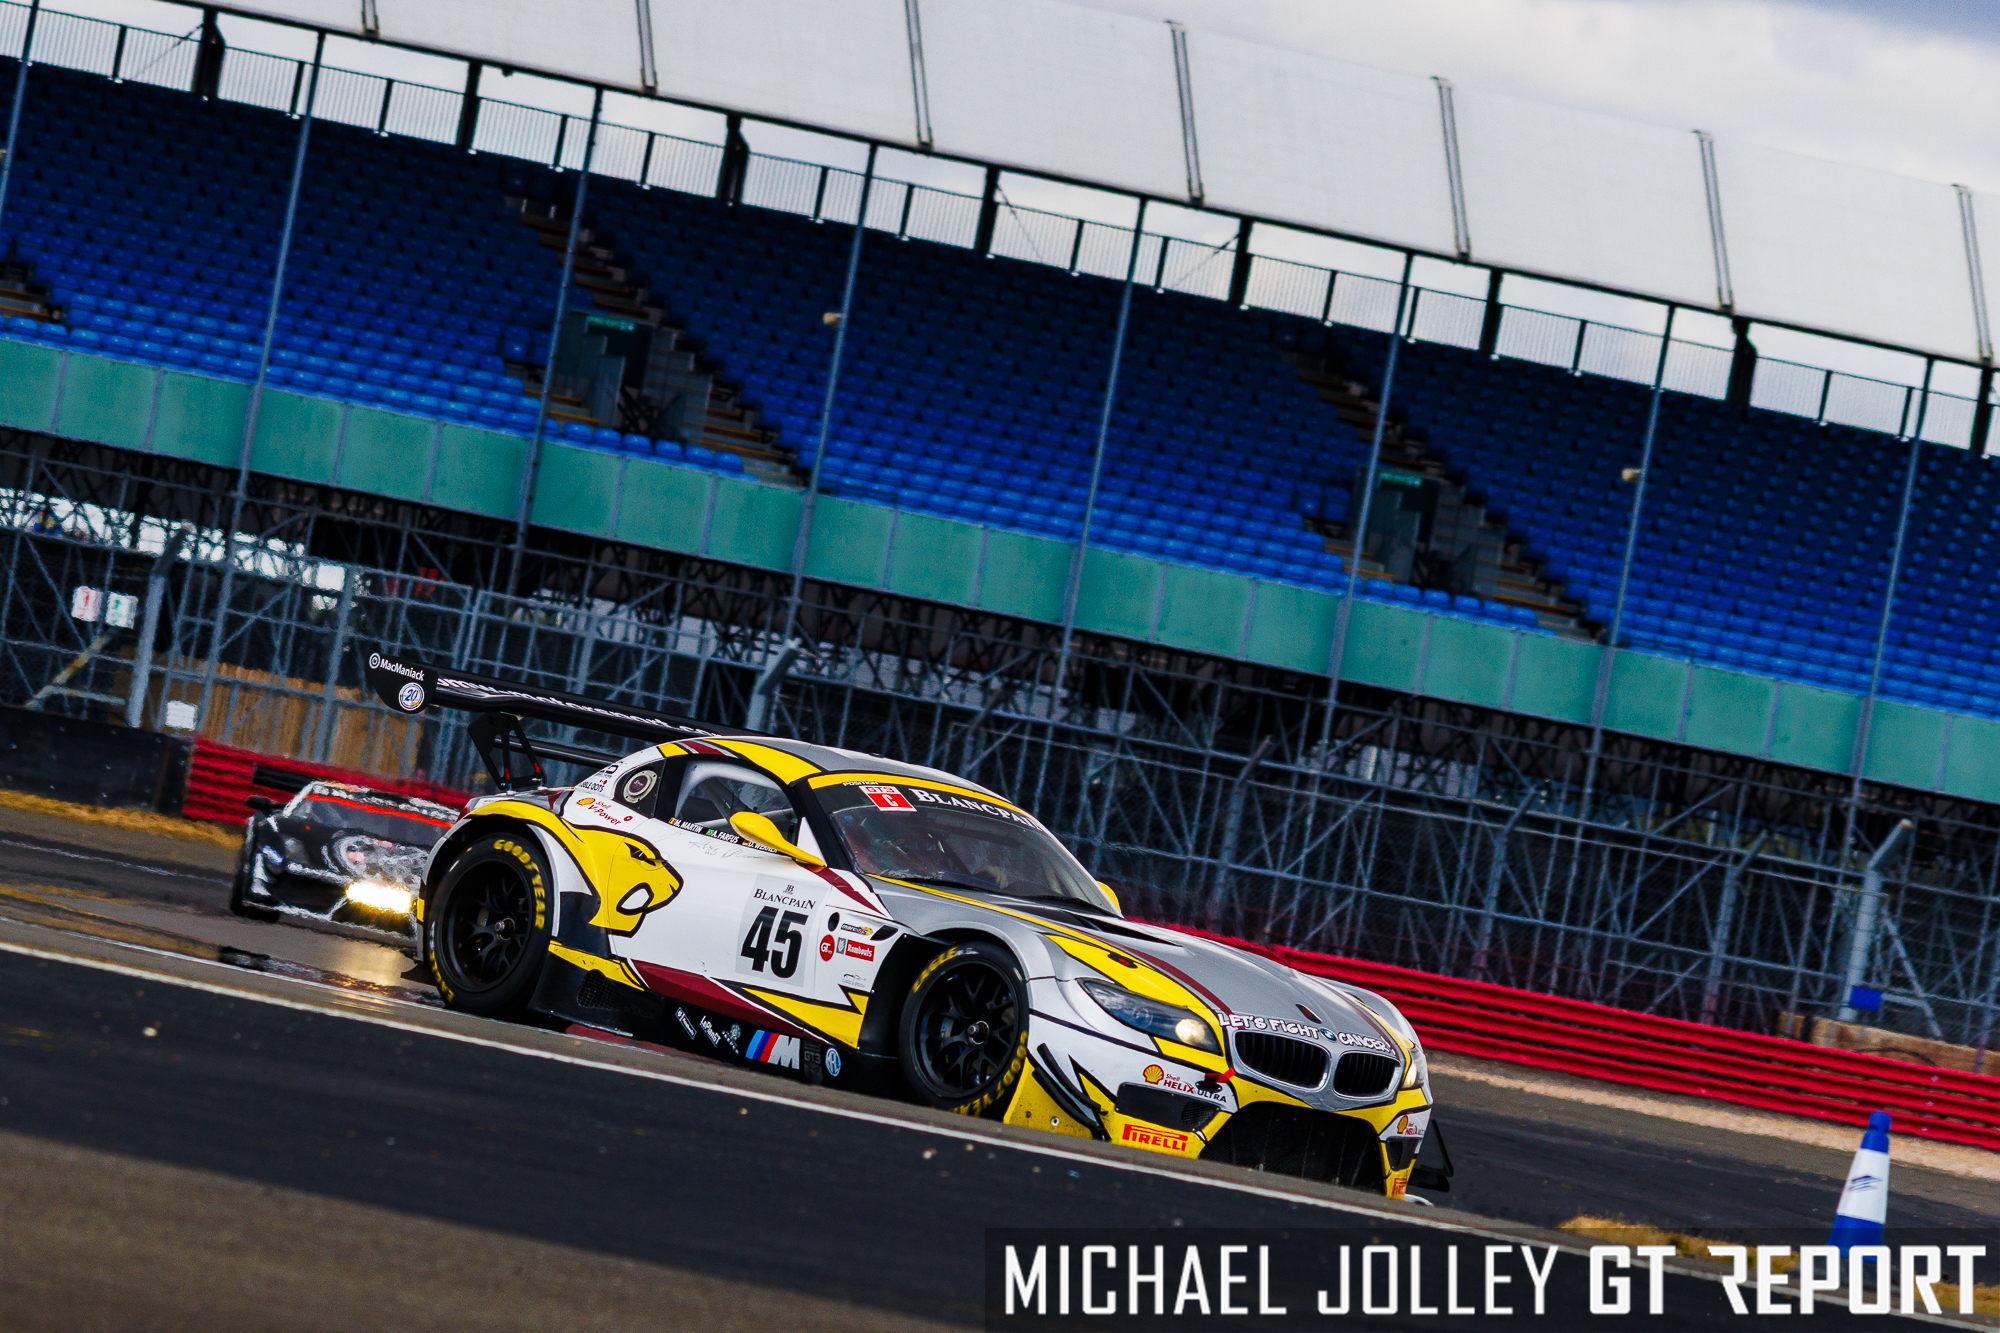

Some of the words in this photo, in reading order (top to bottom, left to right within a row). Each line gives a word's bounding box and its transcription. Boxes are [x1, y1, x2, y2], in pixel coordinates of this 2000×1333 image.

[380, 658, 425, 681] MacManiack
[404, 688, 419, 702] 20
[881, 794, 899, 807] C
[588, 804, 622, 825] V-Power
[681, 822, 703, 833] MARTIN
[718, 832, 740, 843] FARFUS
[493, 839, 546, 930] GOODYEAR
[753, 888, 817, 910] BLANCPAIN
[740, 905, 809, 979] 45
[1217, 1012, 1267, 1029] LET'S
[804, 1050, 821, 1064] GT3
[1166, 1073, 1181, 1082] Shell
[1163, 1079, 1196, 1095] HELIX
[1197, 1089, 1227, 1103] ULTRA
[1122, 1124, 1189, 1152] PIRELLI
